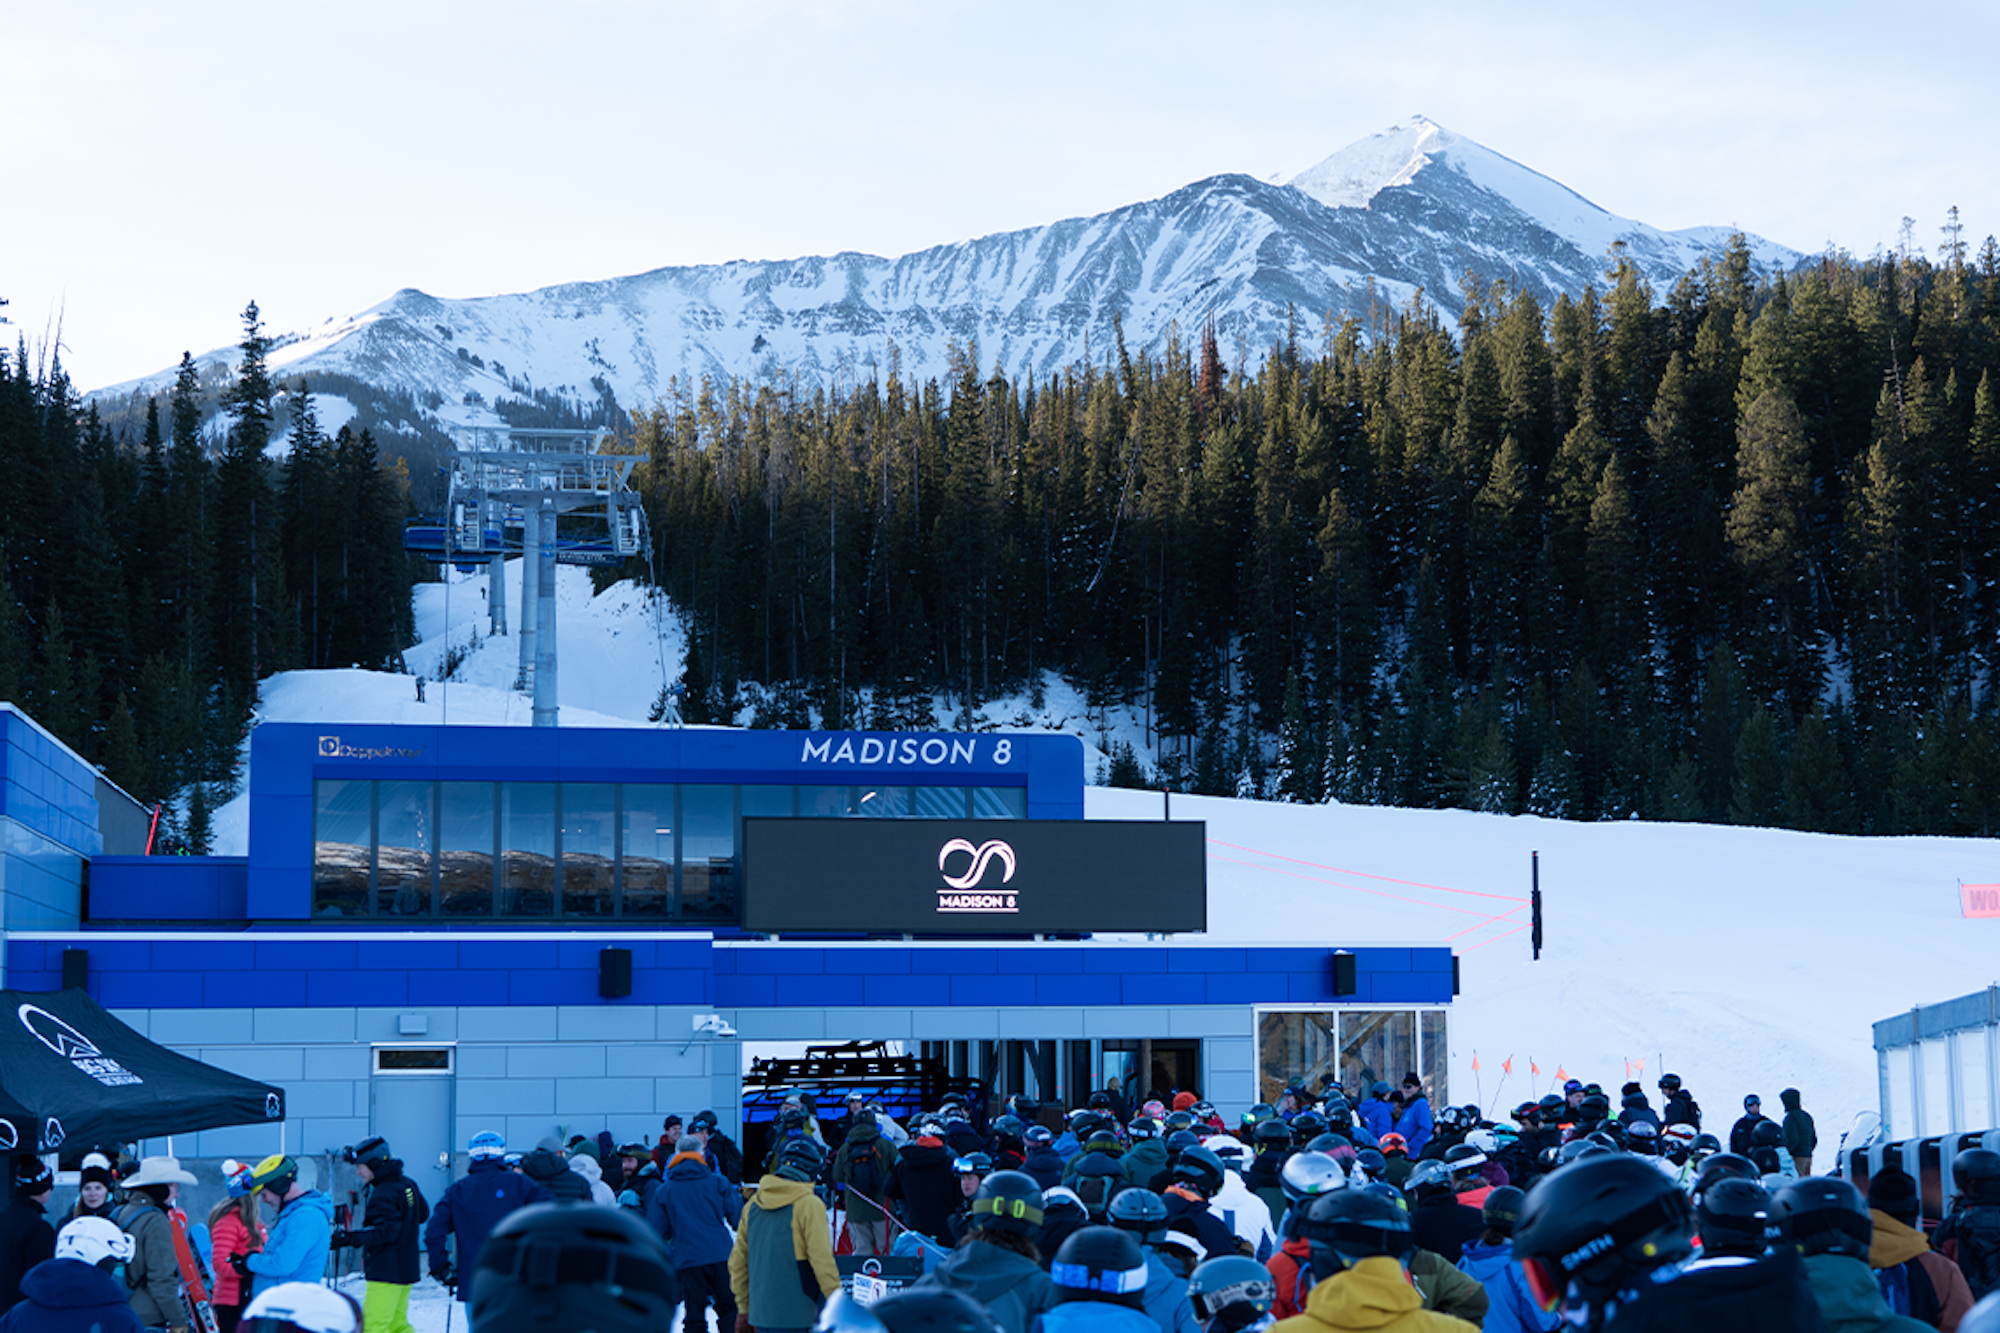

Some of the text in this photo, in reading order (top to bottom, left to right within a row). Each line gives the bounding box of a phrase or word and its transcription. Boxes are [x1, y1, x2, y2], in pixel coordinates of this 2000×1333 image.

[801, 737, 1012, 765] MADISON 8
[939, 895, 1017, 908] MADISON 8
[1561, 1233, 1615, 1271] SMITH
